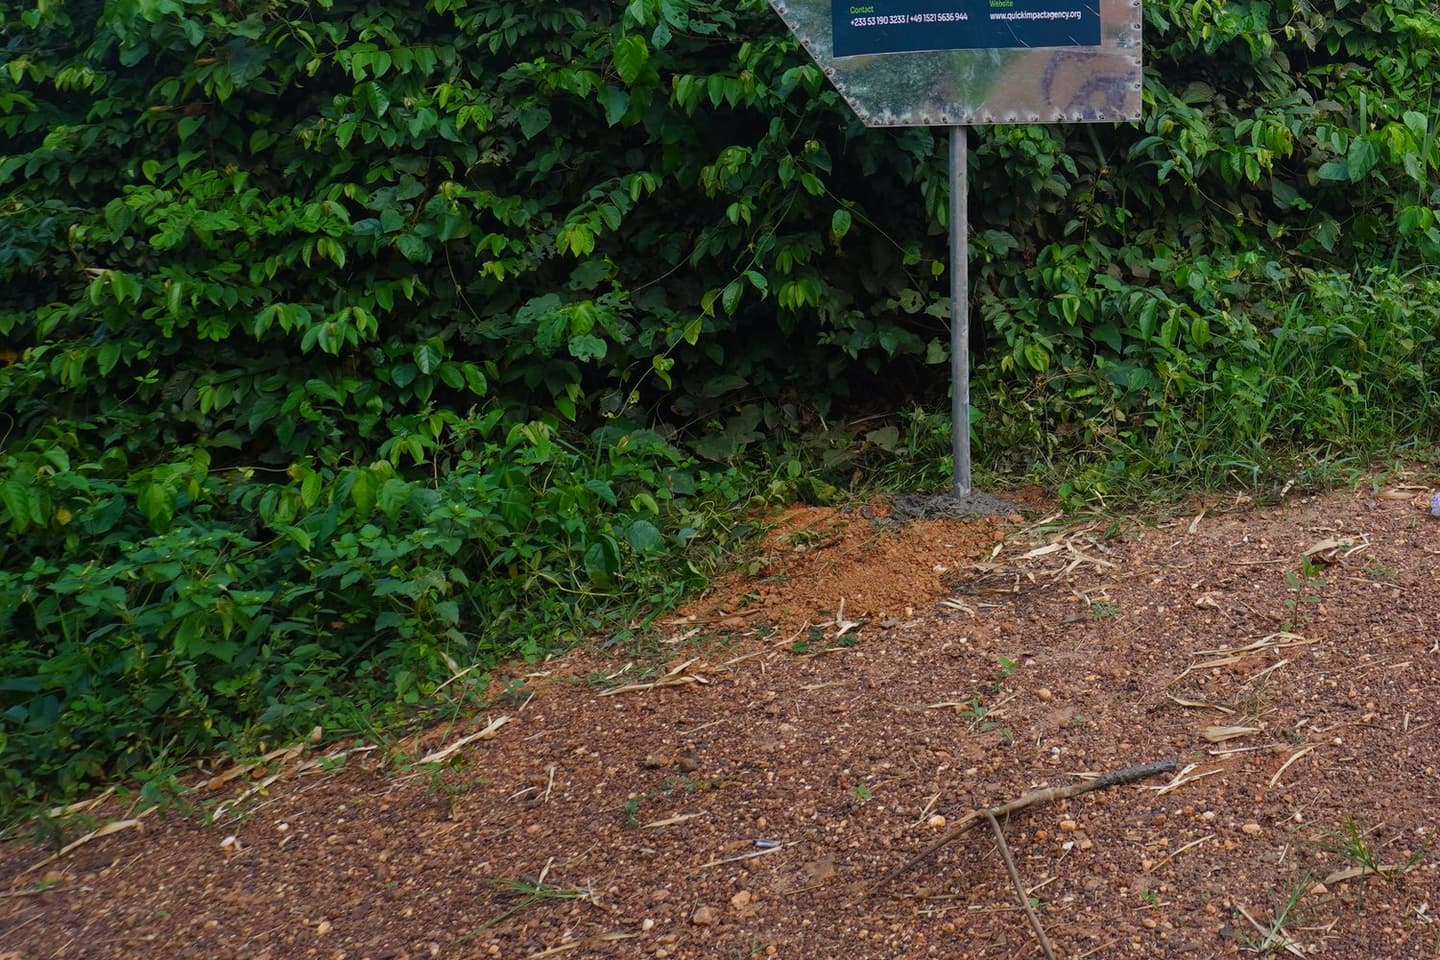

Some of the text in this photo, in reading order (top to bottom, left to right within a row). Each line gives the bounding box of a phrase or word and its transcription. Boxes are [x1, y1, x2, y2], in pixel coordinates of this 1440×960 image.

[989, 0, 1013, 8] Website
[849, 5, 874, 14] Contact
[850, 18, 866, 27] +233
[867, 17, 876, 26] 53
[876, 16, 889, 25] 190
[889, 15, 906, 24] 3233
[910, 14, 923, 23] +49
[923, 13, 937, 22] 1521
[955, 12, 968, 21] 944
[989, 10, 1082, 22] www.quickimpactagency.org
